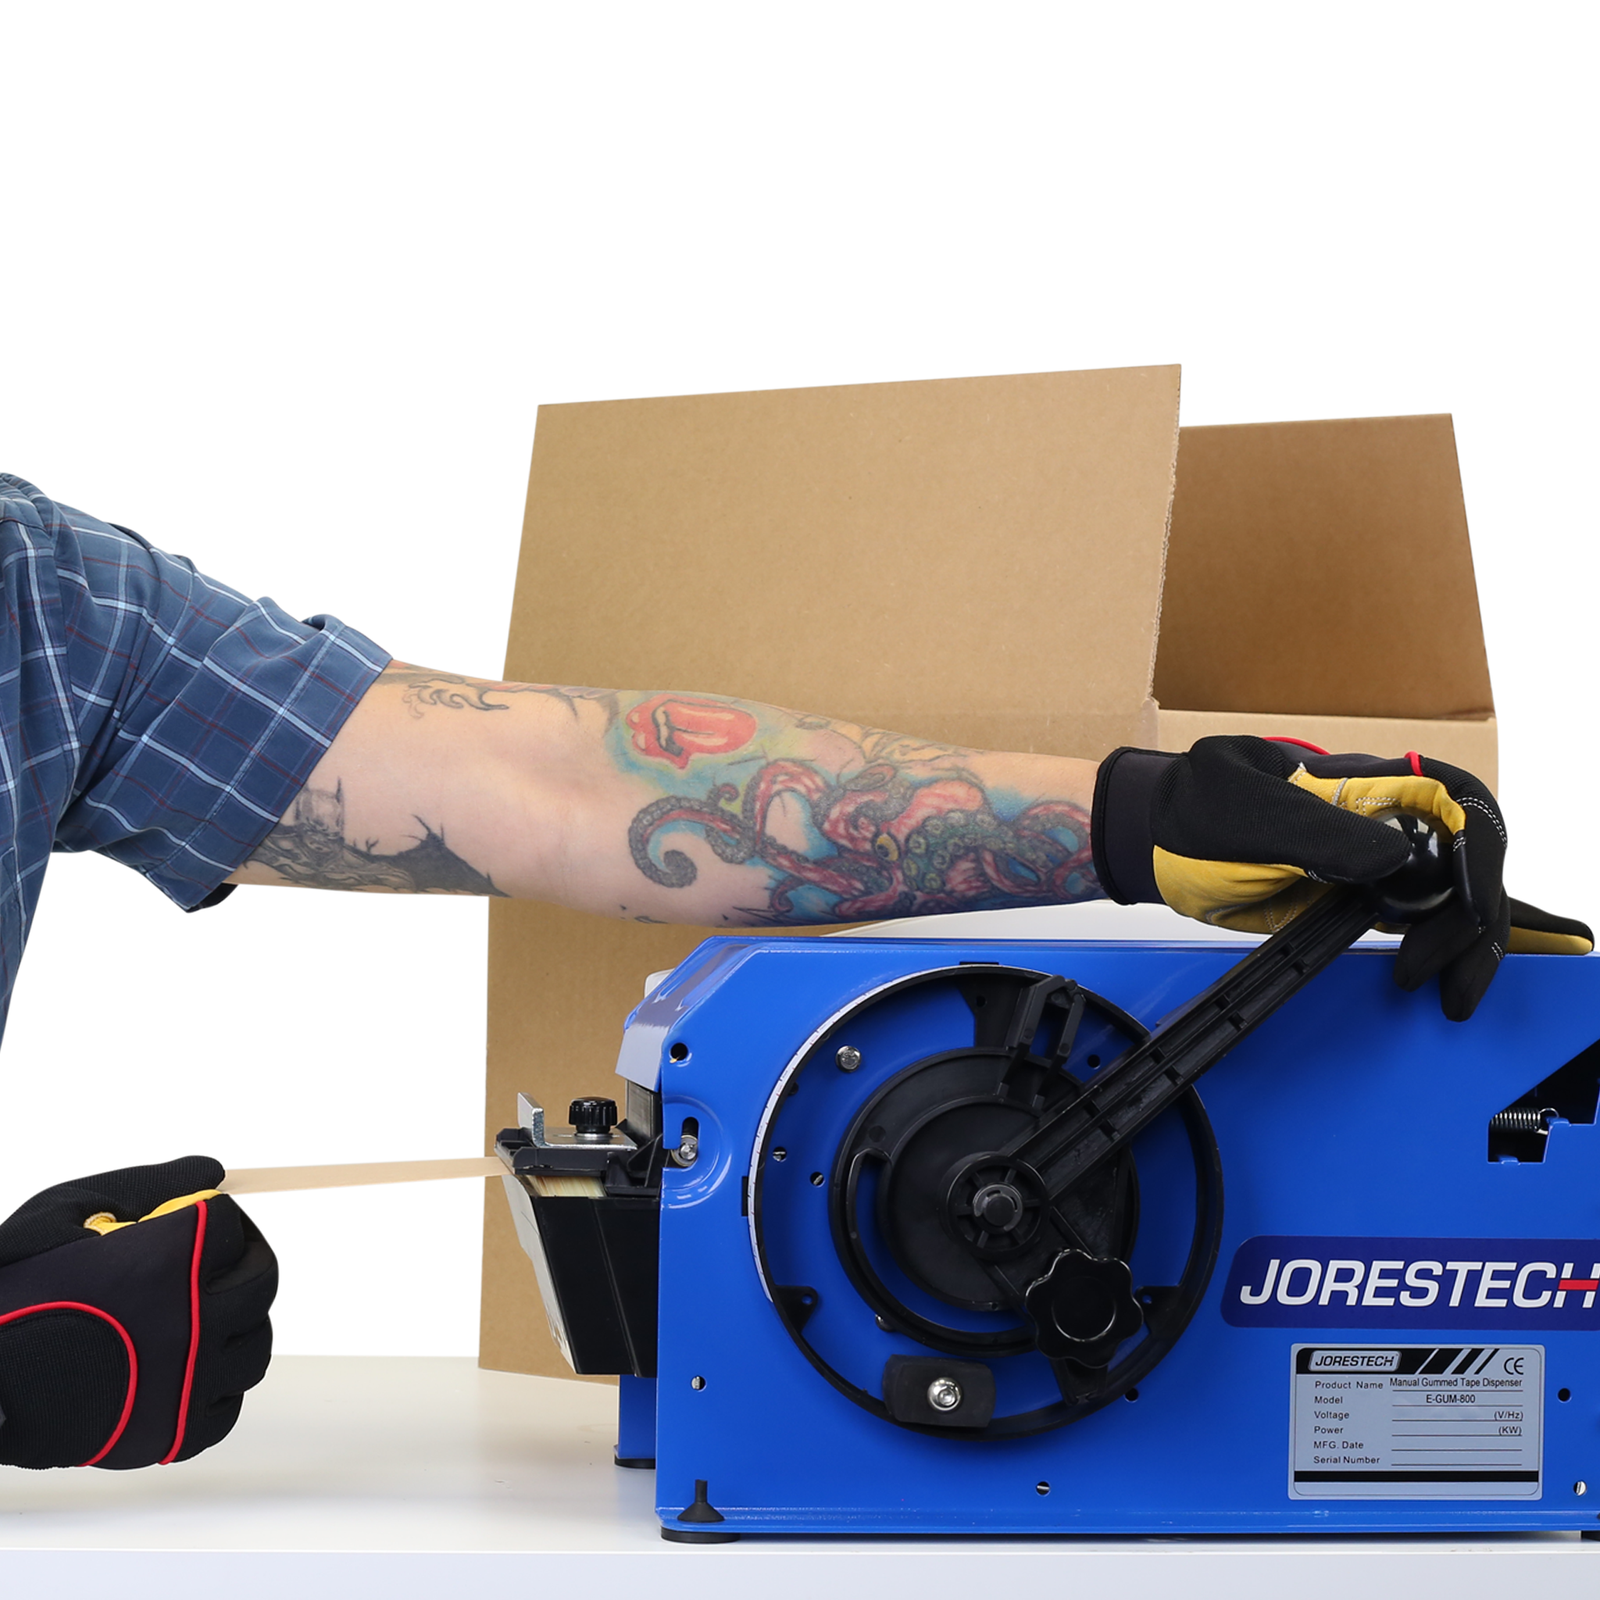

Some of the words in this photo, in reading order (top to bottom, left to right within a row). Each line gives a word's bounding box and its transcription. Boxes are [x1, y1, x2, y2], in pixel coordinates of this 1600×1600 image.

[1240, 1258, 1600, 1308] JORESTECH
[1315, 1355, 1395, 1367] JORESTECH
[1315, 1381, 1352, 1389] Product
[1356, 1381, 1383, 1389] Name
[1389, 1378, 1420, 1387] Manual
[1421, 1378, 1458, 1387] Gummed
[1460, 1378, 1480, 1388] Tape
[1482, 1378, 1522, 1388] Dispenser
[1315, 1396, 1343, 1404] Model
[1426, 1395, 1476, 1403] E-GUM-800
[1314, 1411, 1350, 1420] Voltage
[1494, 1411, 1523, 1421] (V/Hz)
[1314, 1426, 1344, 1434] Power
[1498, 1426, 1522, 1435] (KW)
[1313, 1441, 1339, 1449] MFG.
[1342, 1441, 1364, 1449] Date
[1313, 1456, 1341, 1464] Serial
[1343, 1456, 1380, 1464] Number
